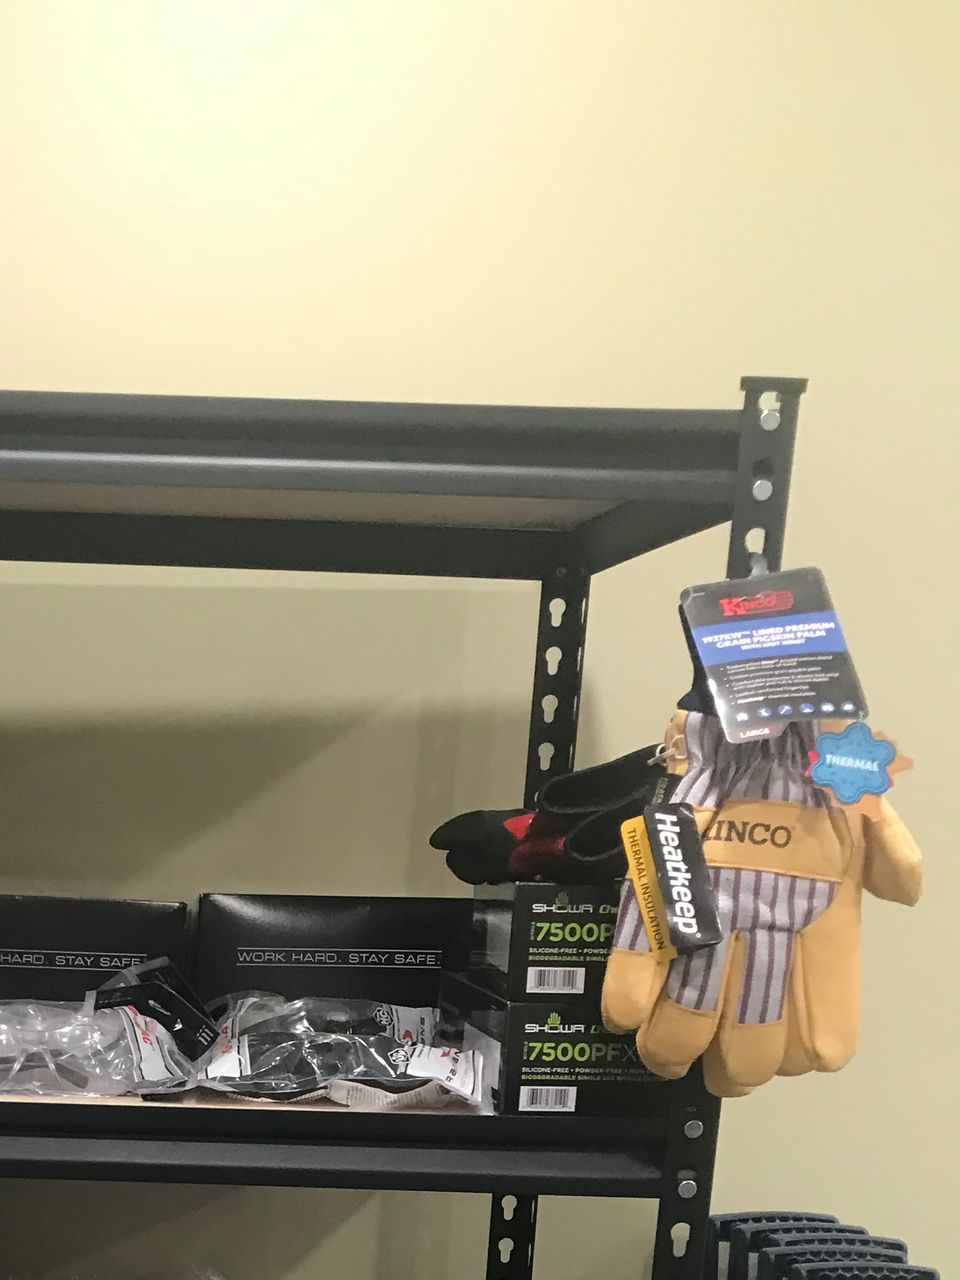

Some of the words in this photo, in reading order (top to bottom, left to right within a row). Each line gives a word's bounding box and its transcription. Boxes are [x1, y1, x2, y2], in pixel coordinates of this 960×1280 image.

[785, 621, 835, 634] PREMIUM
[825, 754, 880, 772] THERMAL
[626, 826, 645, 882] THERMAL
[654, 811, 699, 938] Heatkeep
[531, 903, 594, 913] SHOWA
[640, 881, 666, 951] INSULATION
[536, 922, 614, 942] 7500P
[0, 953, 48, 965] HARD.
[55, 955, 94, 967] STAY
[237, 951, 286, 963] WORK
[292, 951, 342, 964] HARD.
[348, 952, 391, 964] STAY
[395, 952, 442, 965] SAFE.
[524, 1024, 585, 1033] SHOWA
